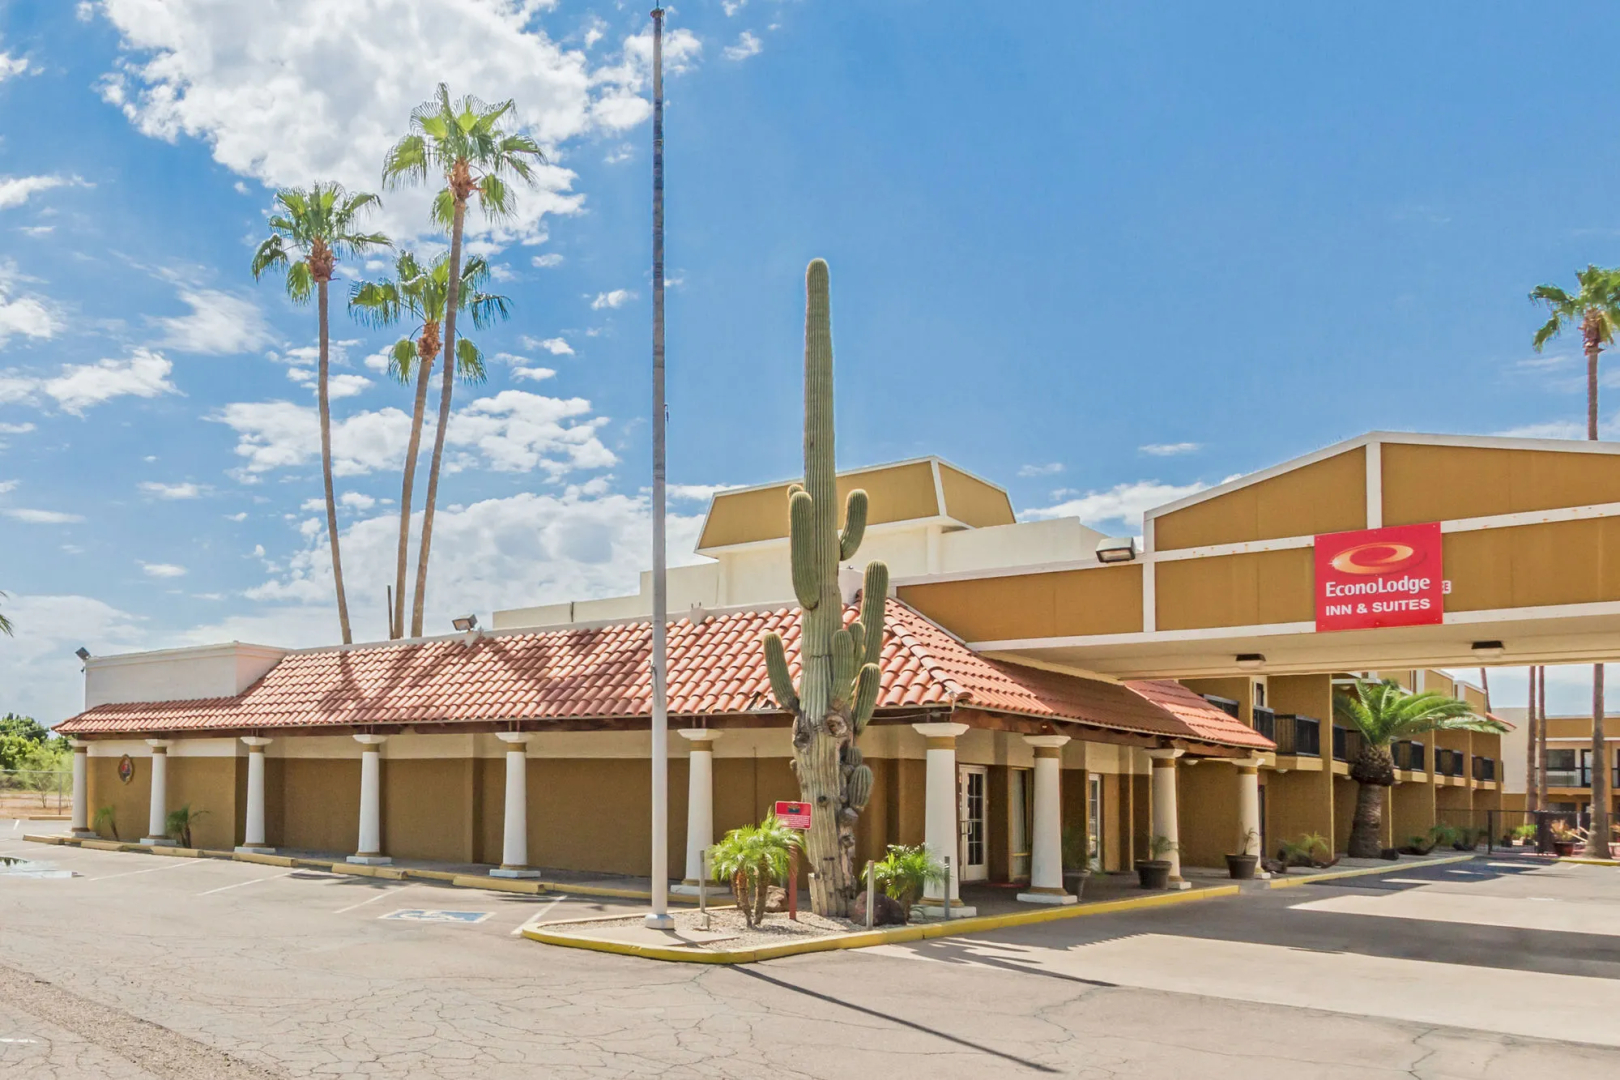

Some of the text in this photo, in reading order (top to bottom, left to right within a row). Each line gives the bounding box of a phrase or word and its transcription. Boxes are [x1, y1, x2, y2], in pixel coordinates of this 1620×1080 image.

[1325, 575, 1430, 597] EconoLodge
[1325, 598, 1431, 616] INN & SUITES
